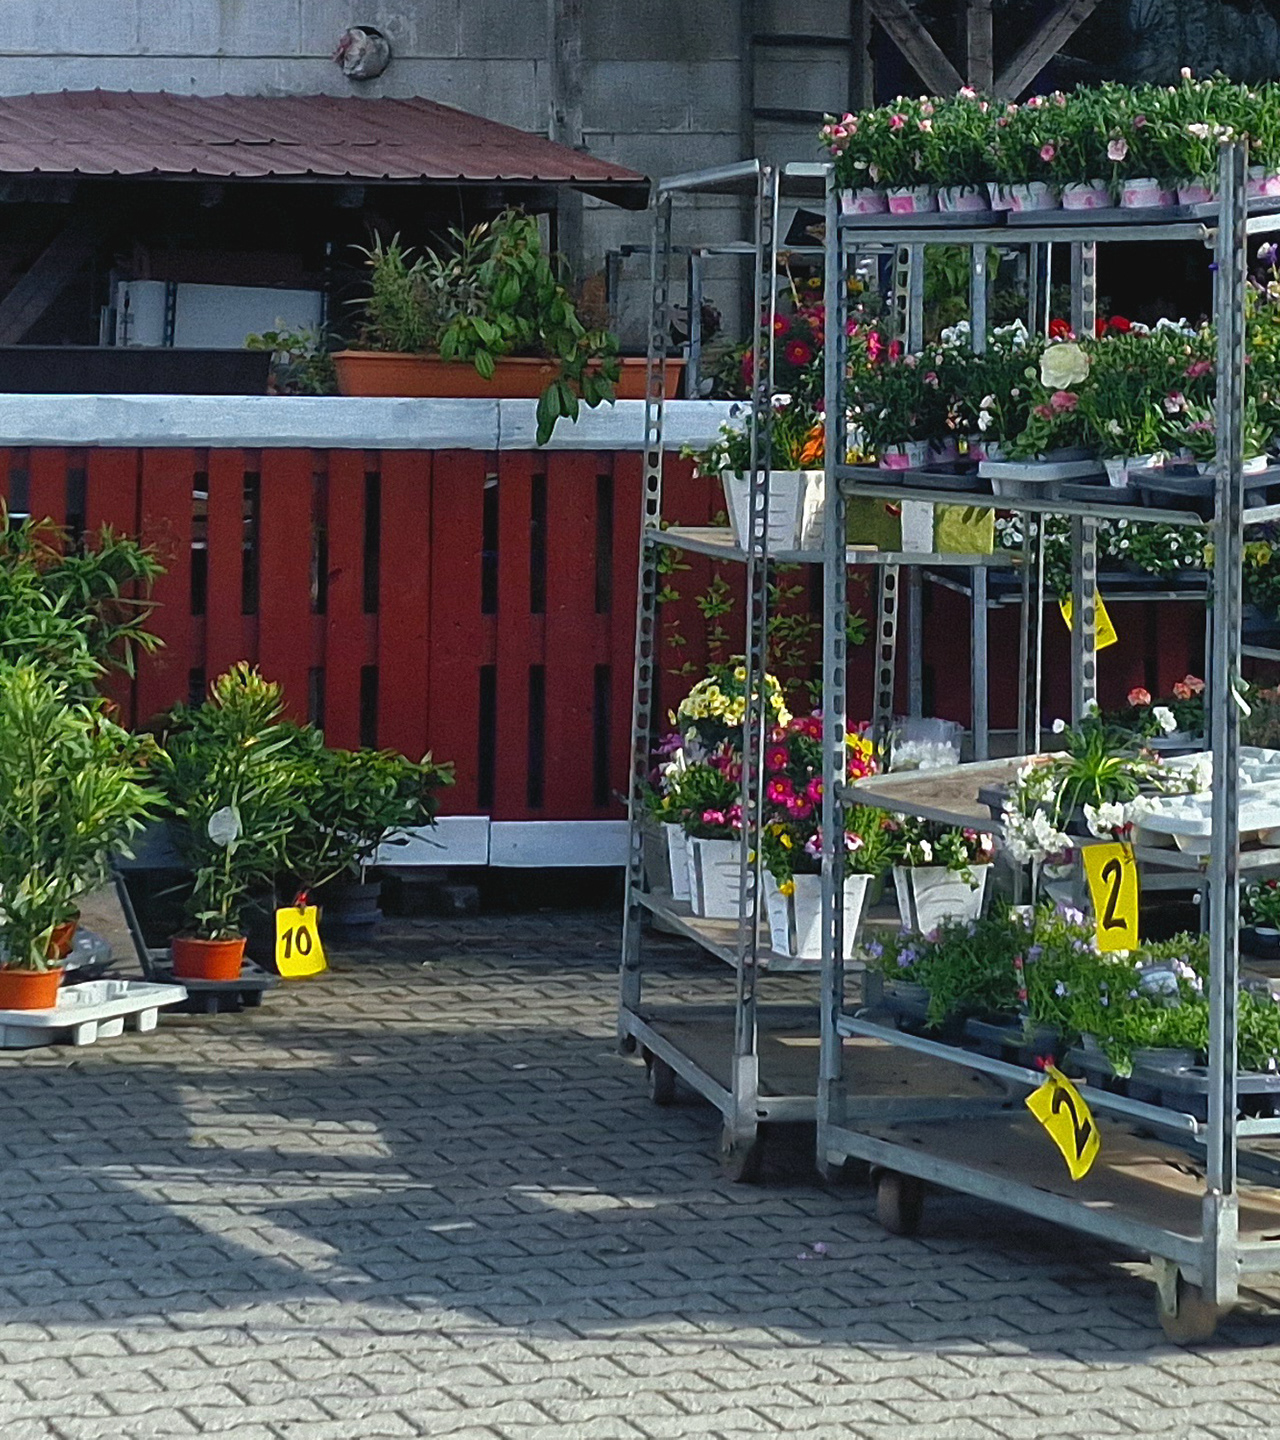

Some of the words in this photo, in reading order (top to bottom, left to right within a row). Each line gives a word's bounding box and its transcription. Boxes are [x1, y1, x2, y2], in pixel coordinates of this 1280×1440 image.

[1101, 857, 1128, 931] 2
[281, 925, 313, 959] 10
[1051, 1085, 1092, 1161] 2
